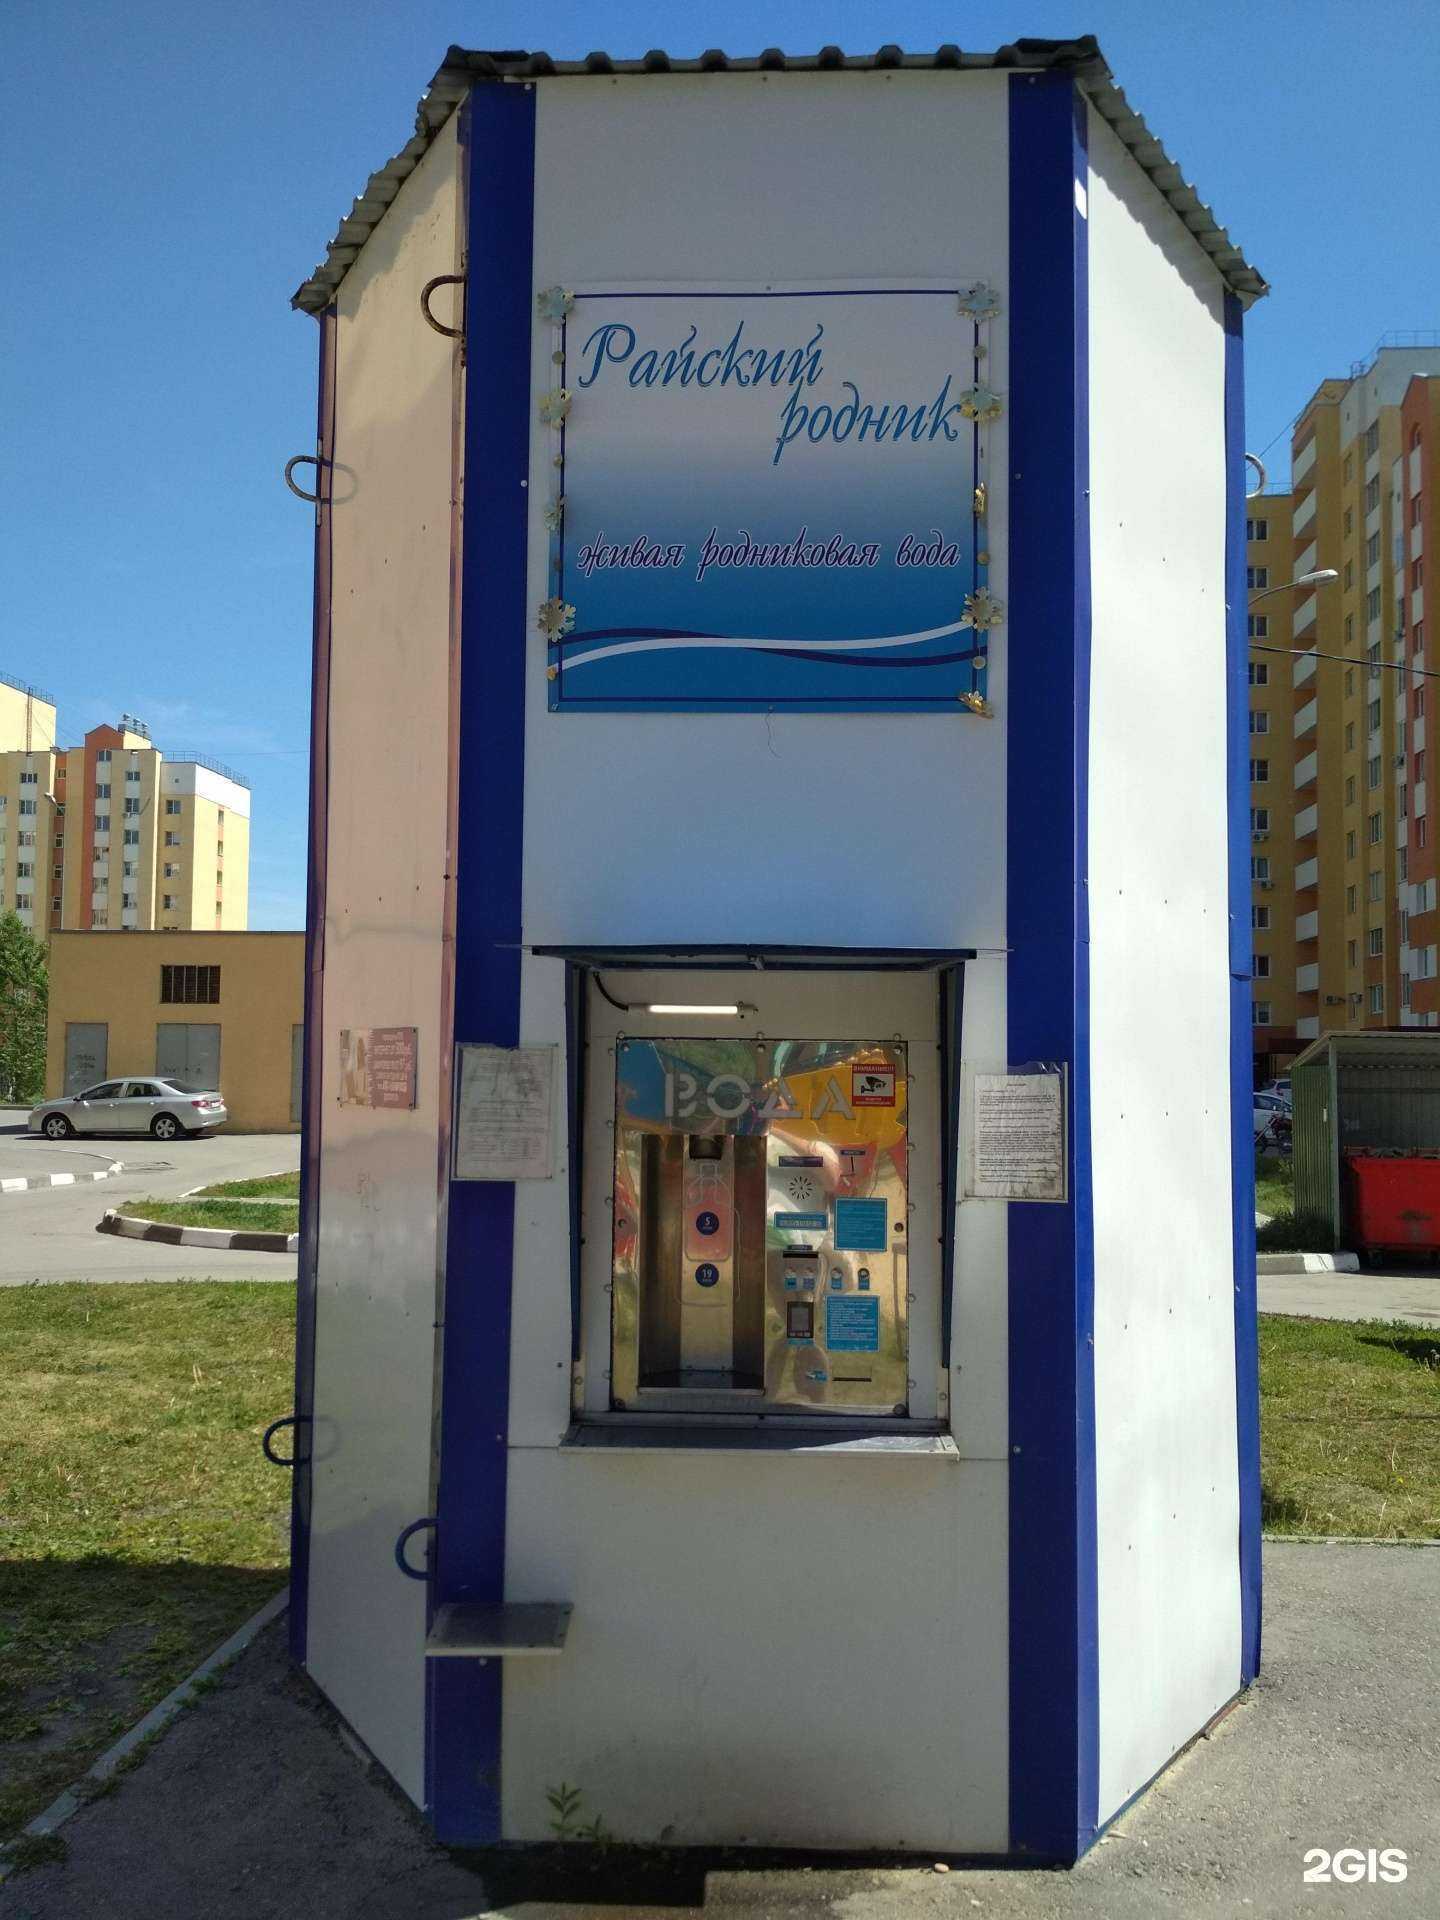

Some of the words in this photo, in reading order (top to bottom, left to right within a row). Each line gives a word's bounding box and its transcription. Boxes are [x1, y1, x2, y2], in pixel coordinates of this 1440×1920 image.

[578, 320, 824, 388] Райский
[773, 374, 962, 465] родник
[577, 530, 686, 577] живая
[695, 526, 881, 582] родниковая
[895, 529, 961, 568] вода
[664, 1073, 857, 1120] ВОДА
[702, 1269, 712, 1278] 19
